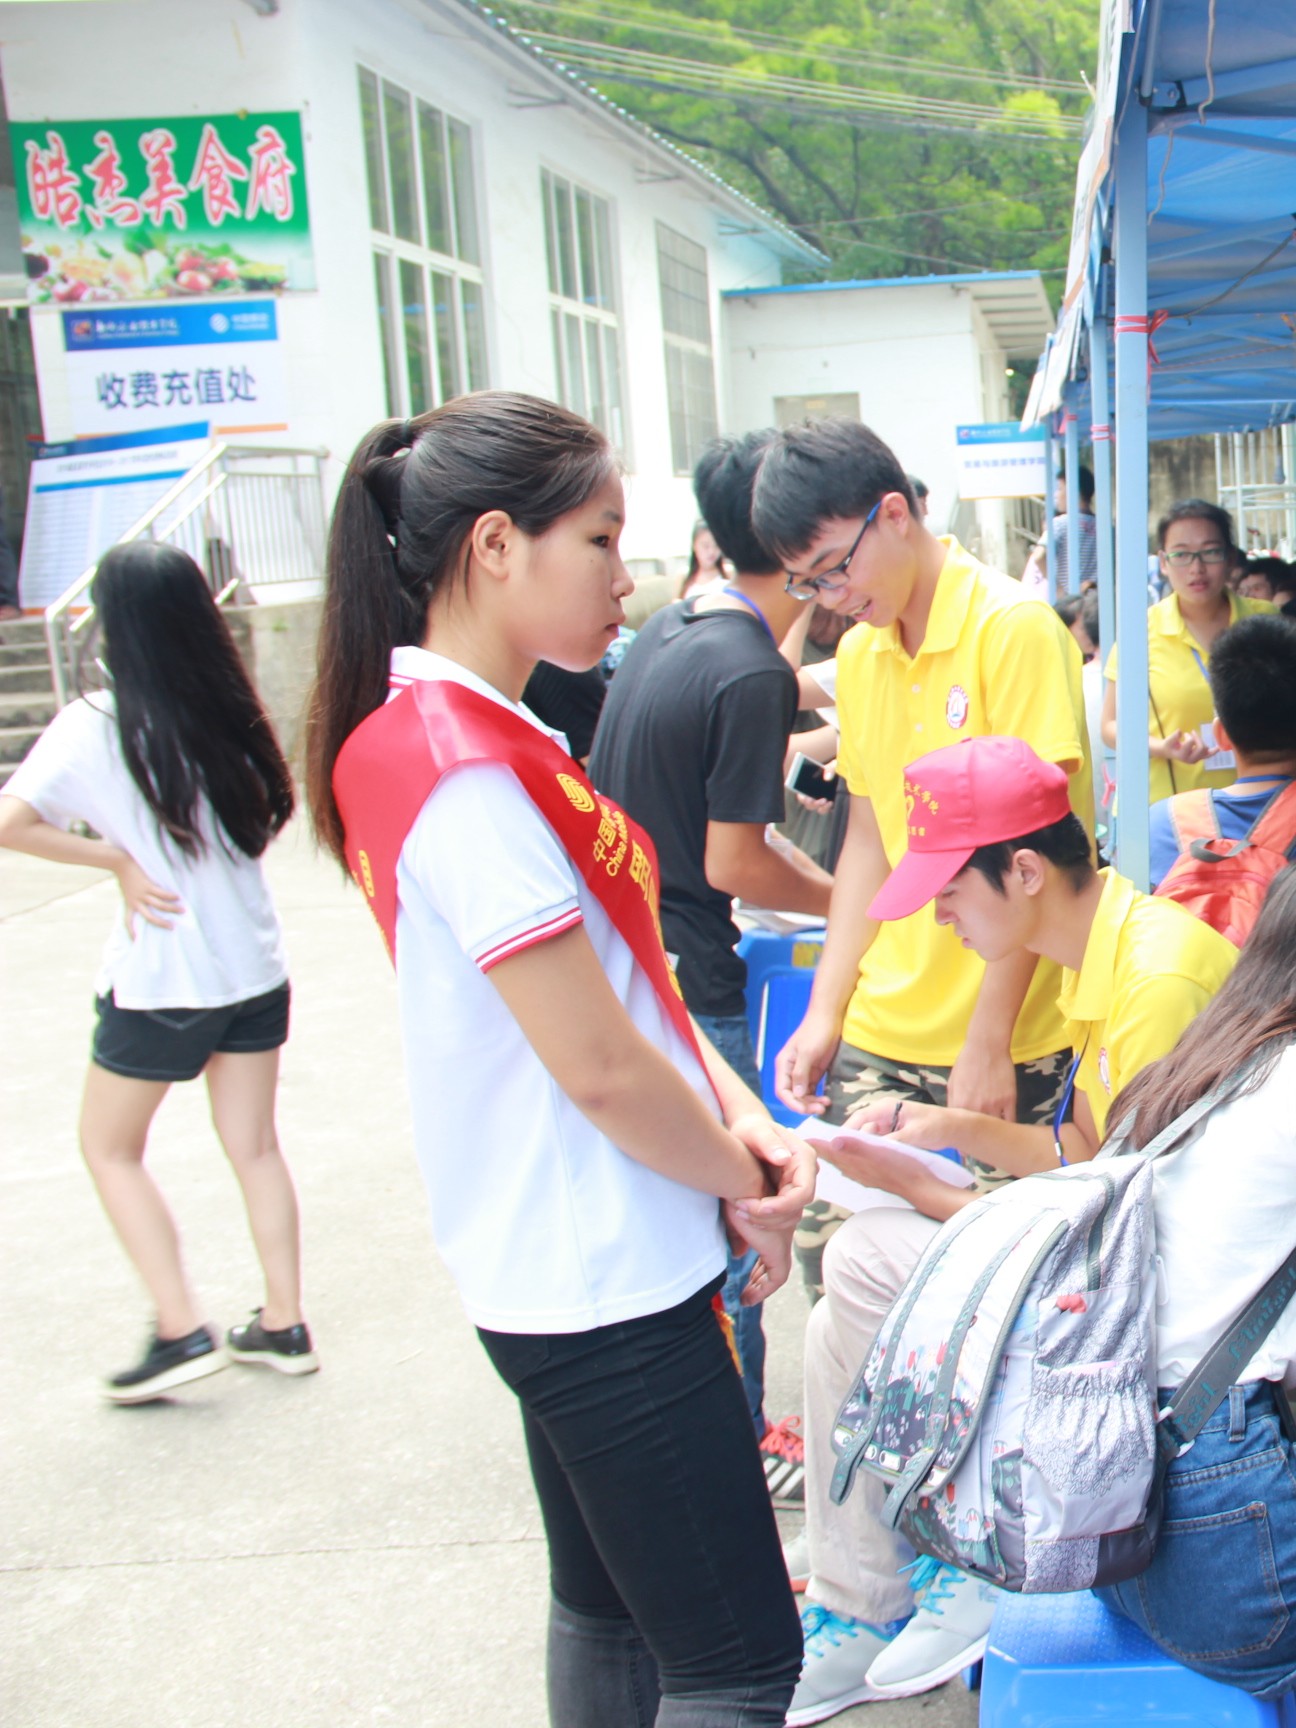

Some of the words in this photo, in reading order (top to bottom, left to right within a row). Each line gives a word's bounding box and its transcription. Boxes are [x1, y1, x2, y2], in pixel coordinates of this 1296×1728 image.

[96, 366, 257, 410] 收费充值处
[606, 841, 627, 877] China
